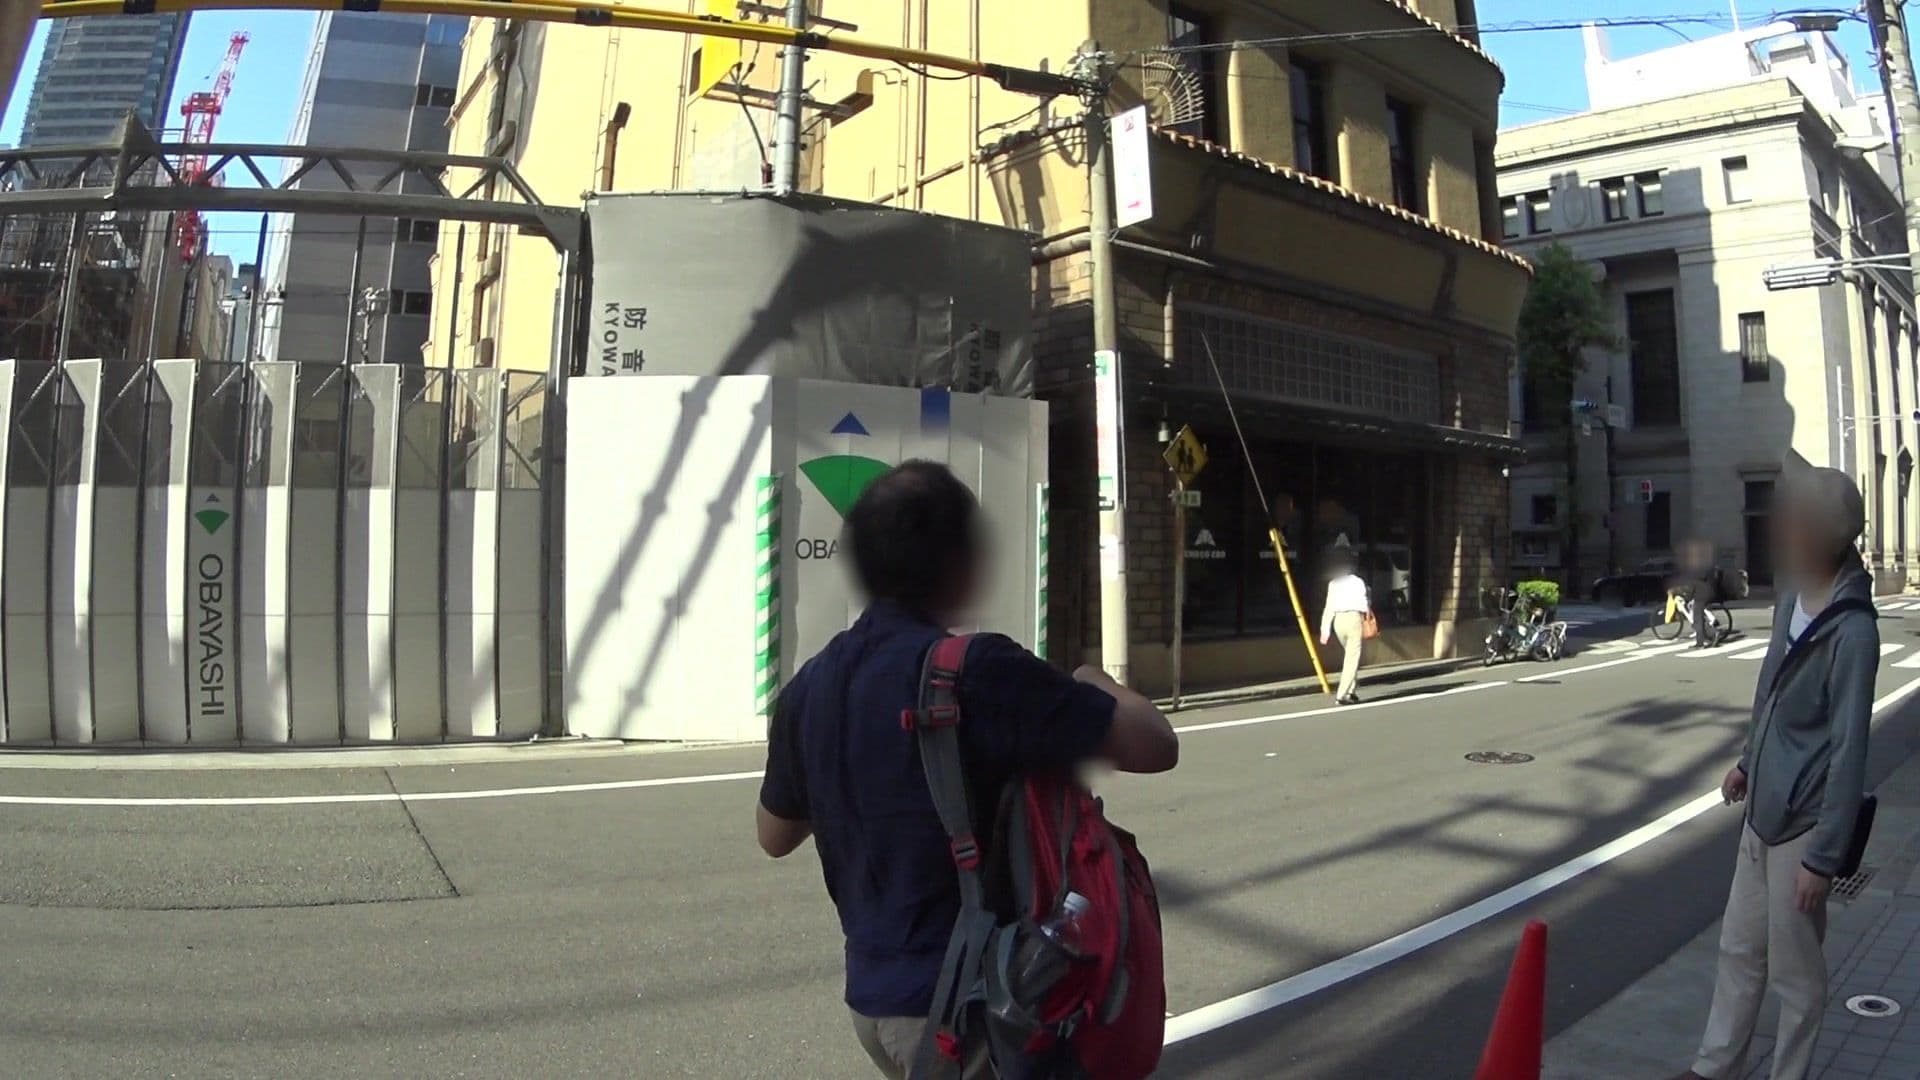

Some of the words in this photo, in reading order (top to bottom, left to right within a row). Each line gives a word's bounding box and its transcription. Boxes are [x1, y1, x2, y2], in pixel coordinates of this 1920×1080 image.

[602, 302, 619, 377] KYOWA
[621, 307, 647, 373] 防音
[199, 554, 225, 716] OBAYASHI
